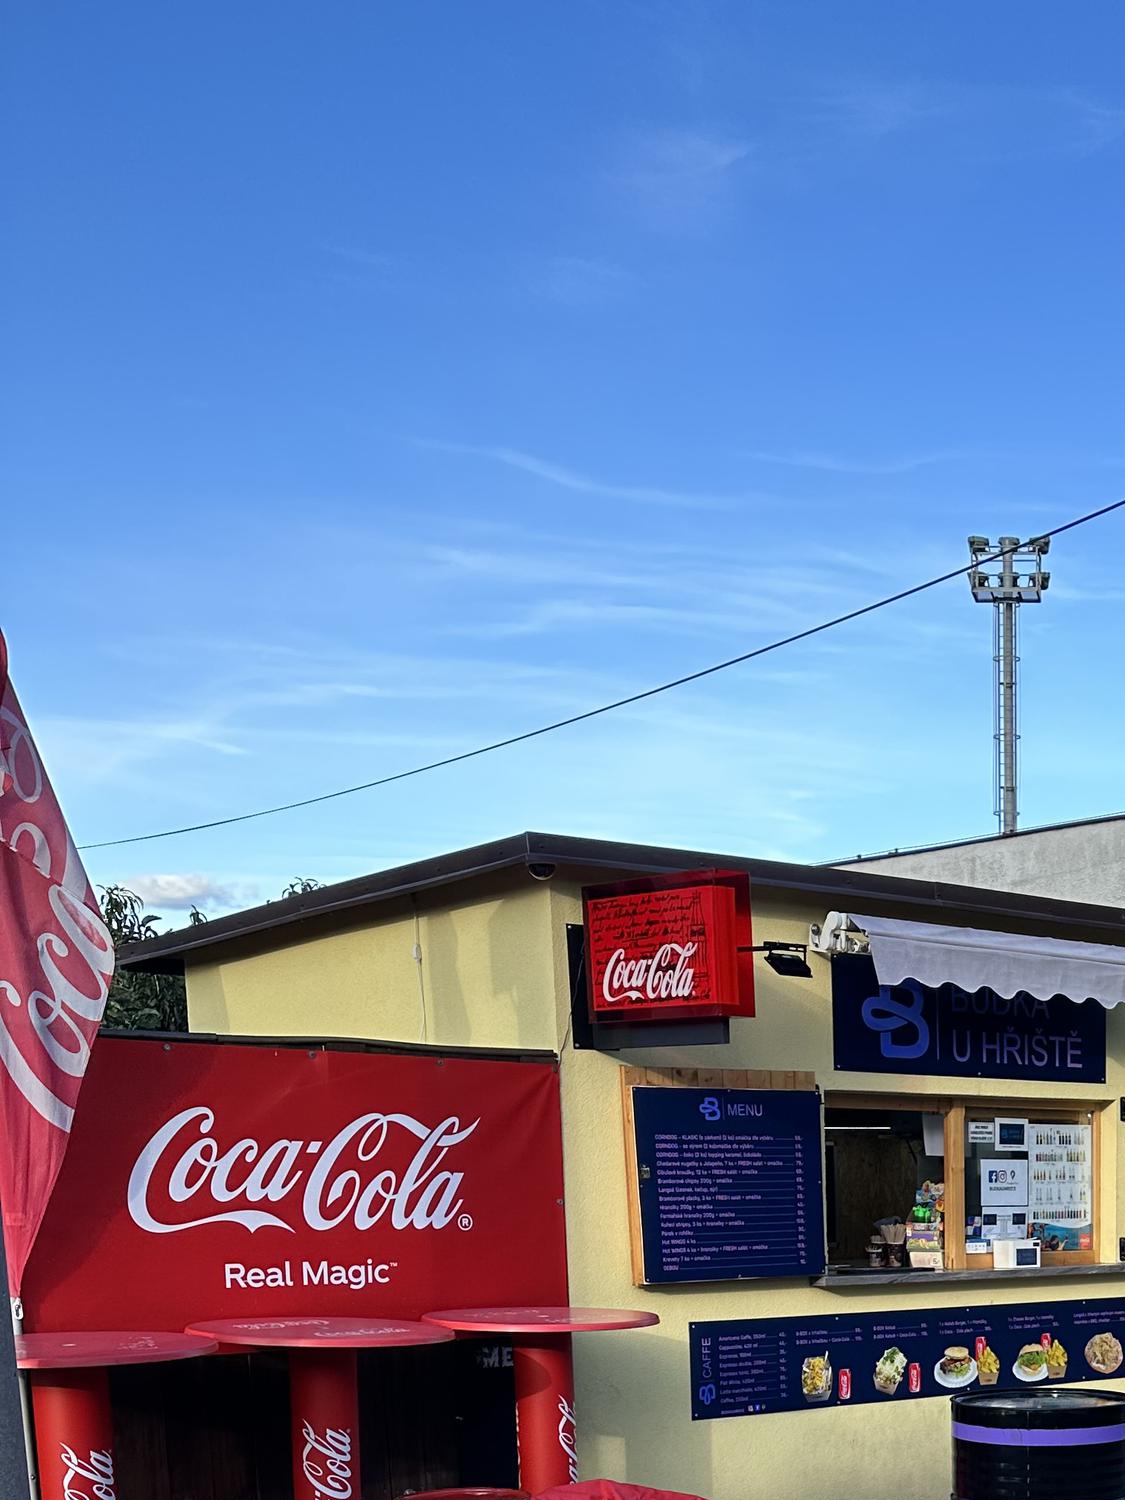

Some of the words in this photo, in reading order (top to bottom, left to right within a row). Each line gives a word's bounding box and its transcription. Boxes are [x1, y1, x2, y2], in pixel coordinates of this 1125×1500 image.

[602, 942, 698, 1002] Coca-Cola
[952, 1029, 971, 1062] U
[982, 1026, 1083, 1068] HŘIŠTĚ
[727, 1103, 763, 1117] MENU
[224, 1260, 293, 1288] Real
[701, 1337, 712, 1378] CAFFE
